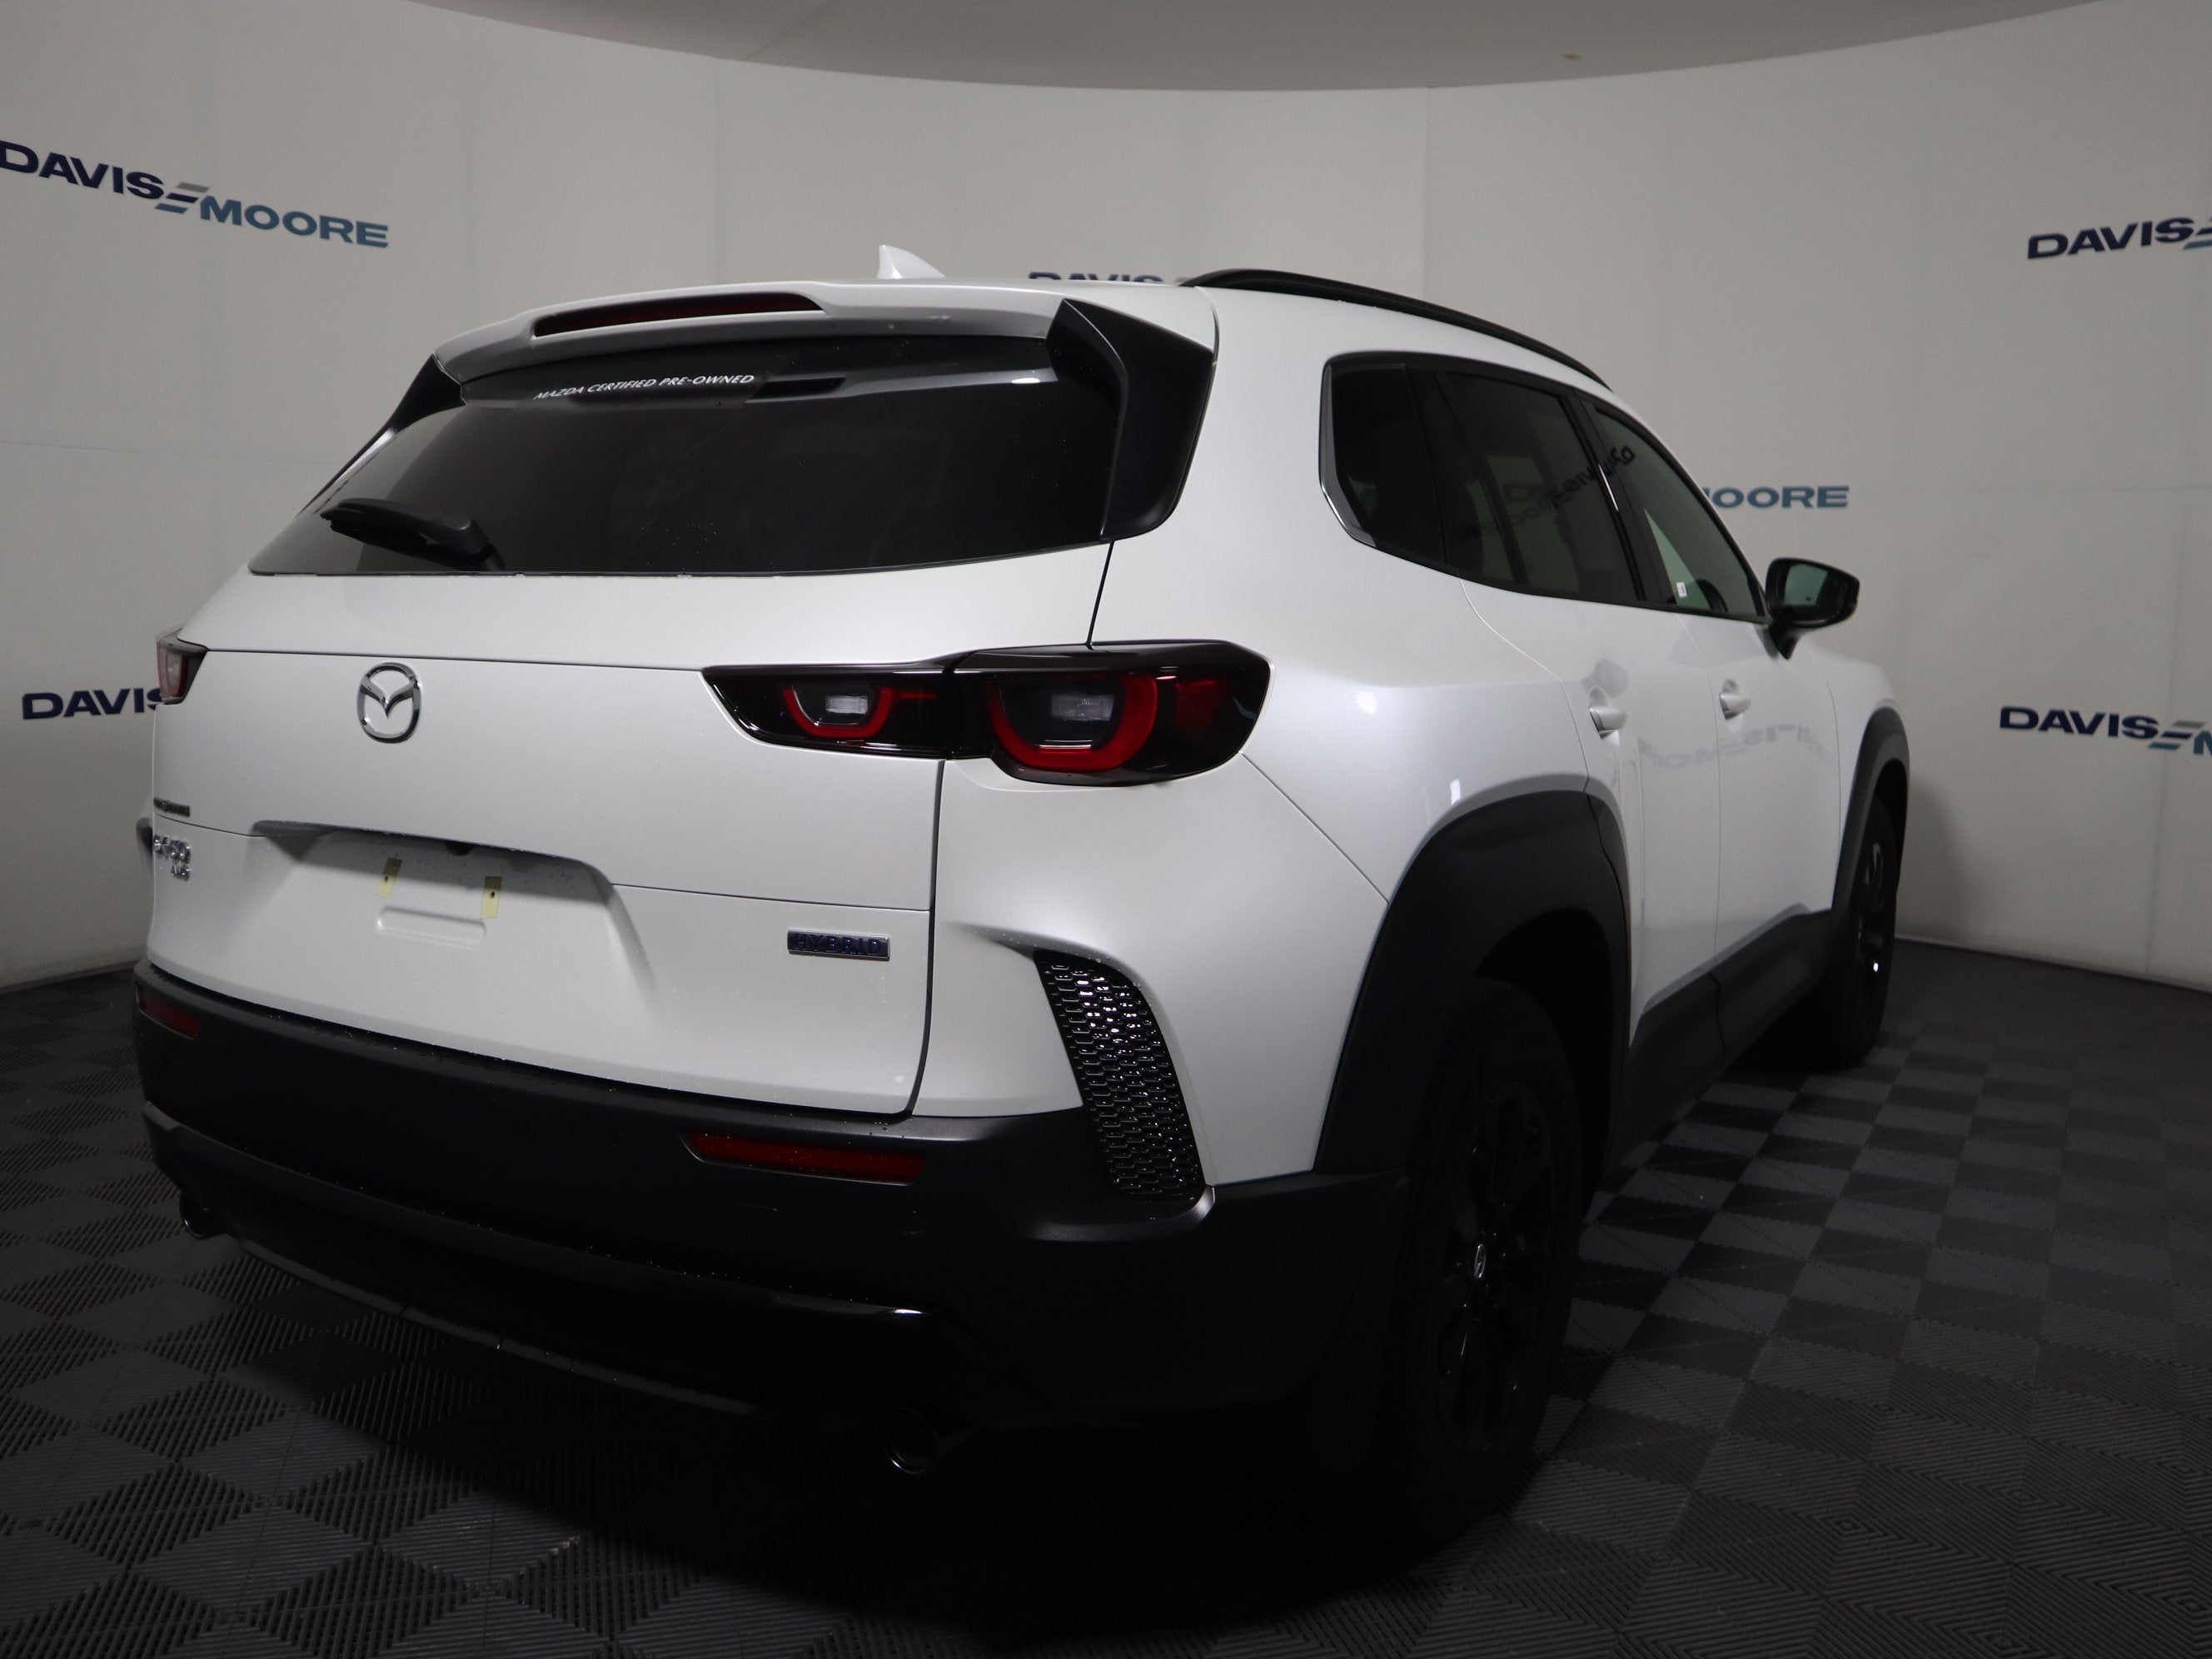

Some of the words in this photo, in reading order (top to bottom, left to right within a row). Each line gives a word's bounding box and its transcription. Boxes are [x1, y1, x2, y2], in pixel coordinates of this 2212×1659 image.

[0, 140, 163, 199] DAVIS
[200, 195, 389, 248] MOORE
[2027, 217, 2195, 259] DAVIS
[532, 386, 585, 400] MAZDA
[587, 378, 657, 393] CERTIFIED
[658, 375, 755, 386] PRE-OWNED
[1702, 486, 1850, 508] OORE
[1999, 705, 2160, 740] DAVIS
